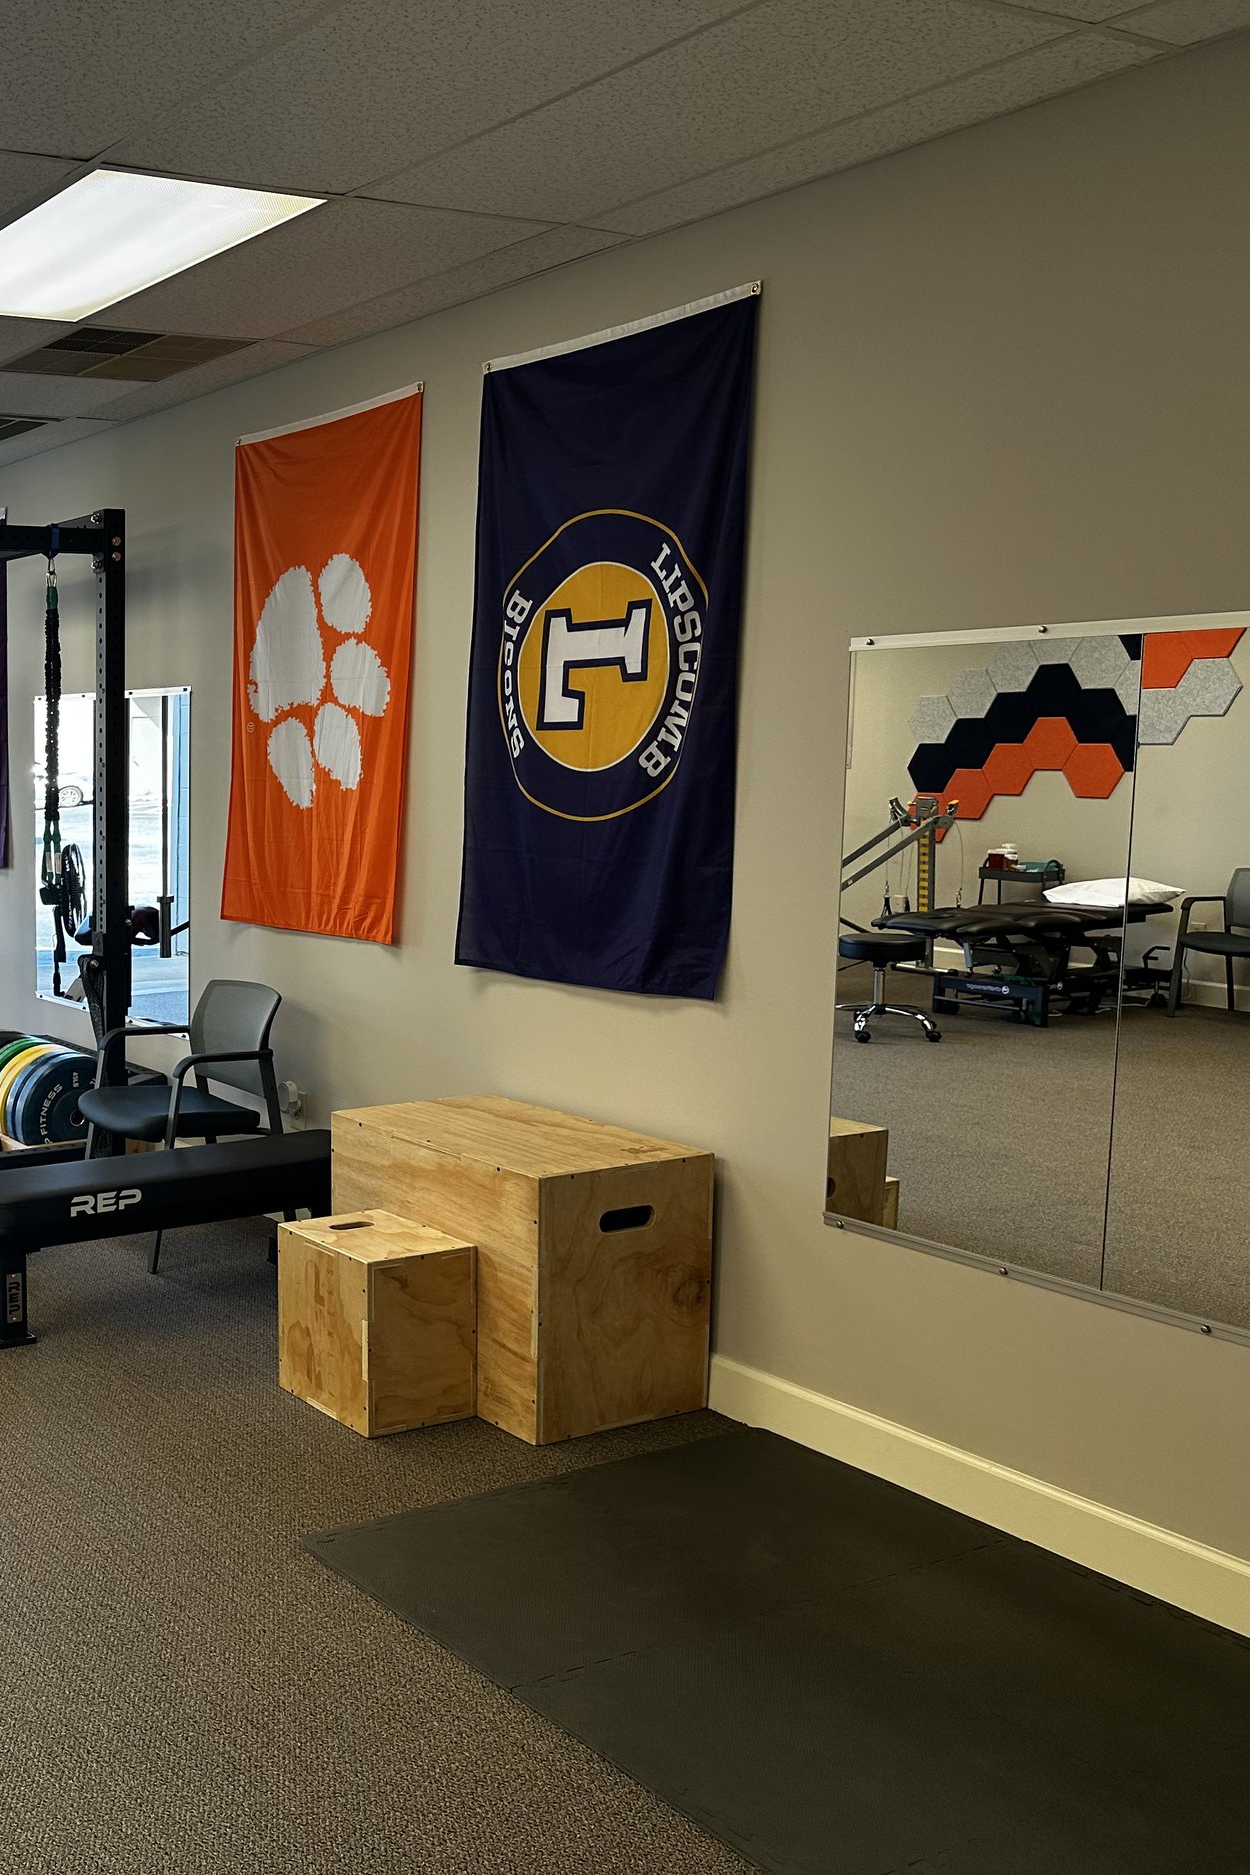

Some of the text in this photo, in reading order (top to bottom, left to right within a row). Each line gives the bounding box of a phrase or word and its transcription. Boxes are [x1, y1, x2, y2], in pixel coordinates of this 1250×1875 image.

[40, 1084, 63, 1135] FITNESS
[70, 1188, 143, 1217] REP
[9, 1282, 20, 1315] REP
